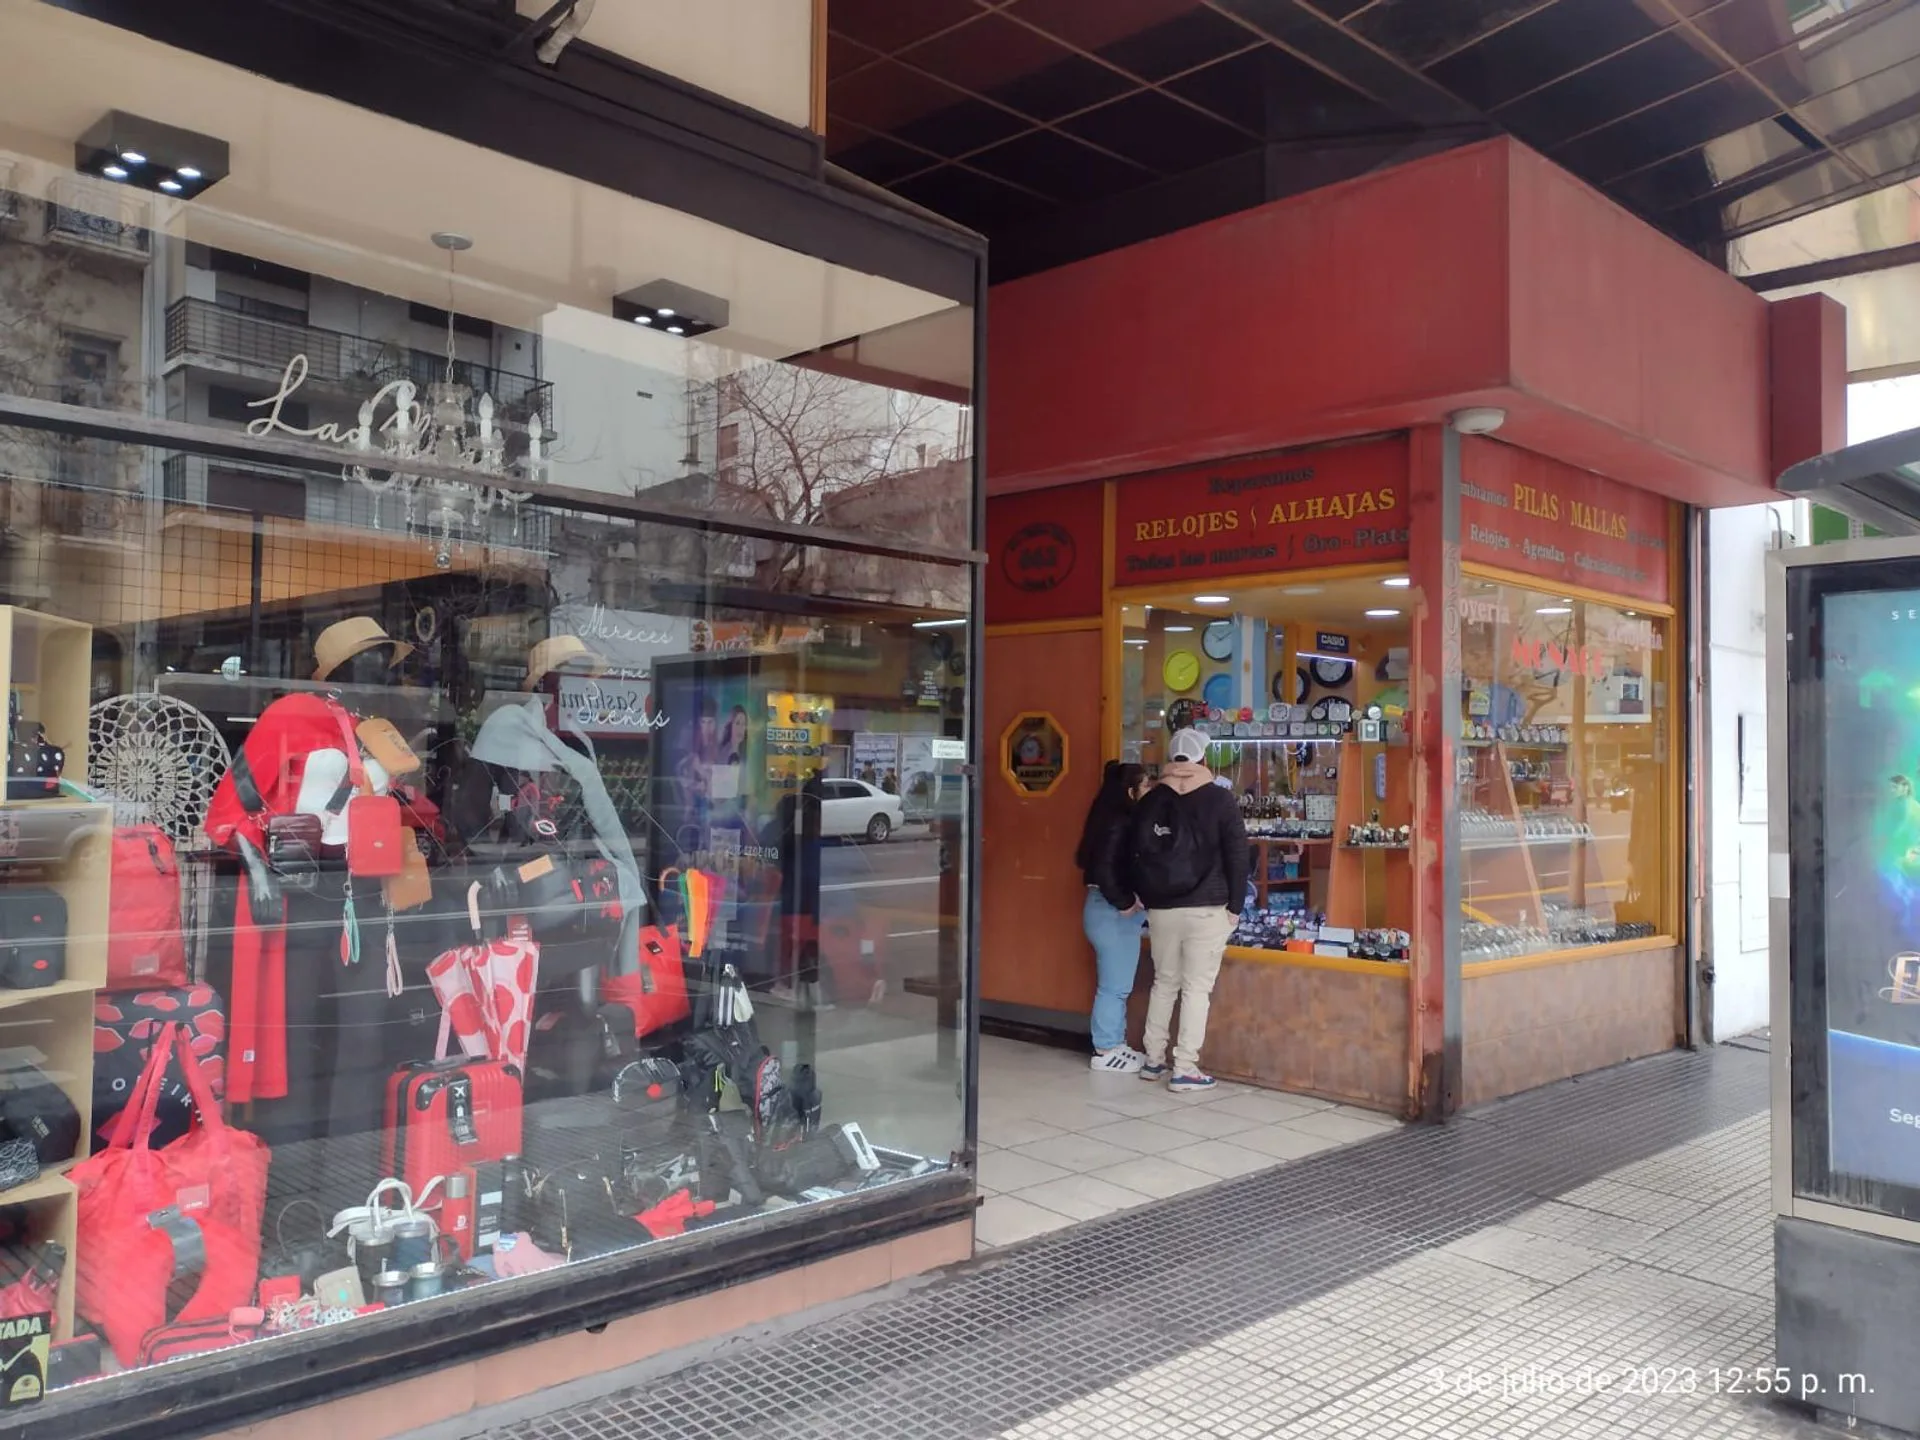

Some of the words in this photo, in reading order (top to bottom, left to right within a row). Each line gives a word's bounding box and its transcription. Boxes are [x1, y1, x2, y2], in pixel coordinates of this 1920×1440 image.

[1135, 510, 1238, 541] RELOJES
[1268, 488, 1396, 525] ALHAJAS
[1514, 483, 1559, 521] PILAS
[1571, 500, 1627, 539] MALLAS
[1304, 535, 1338, 553] Oro
[1471, 524, 1510, 550] Relojes
[1522, 538, 1564, 563] Agendas
[767, 729, 808, 741] SEIKO
